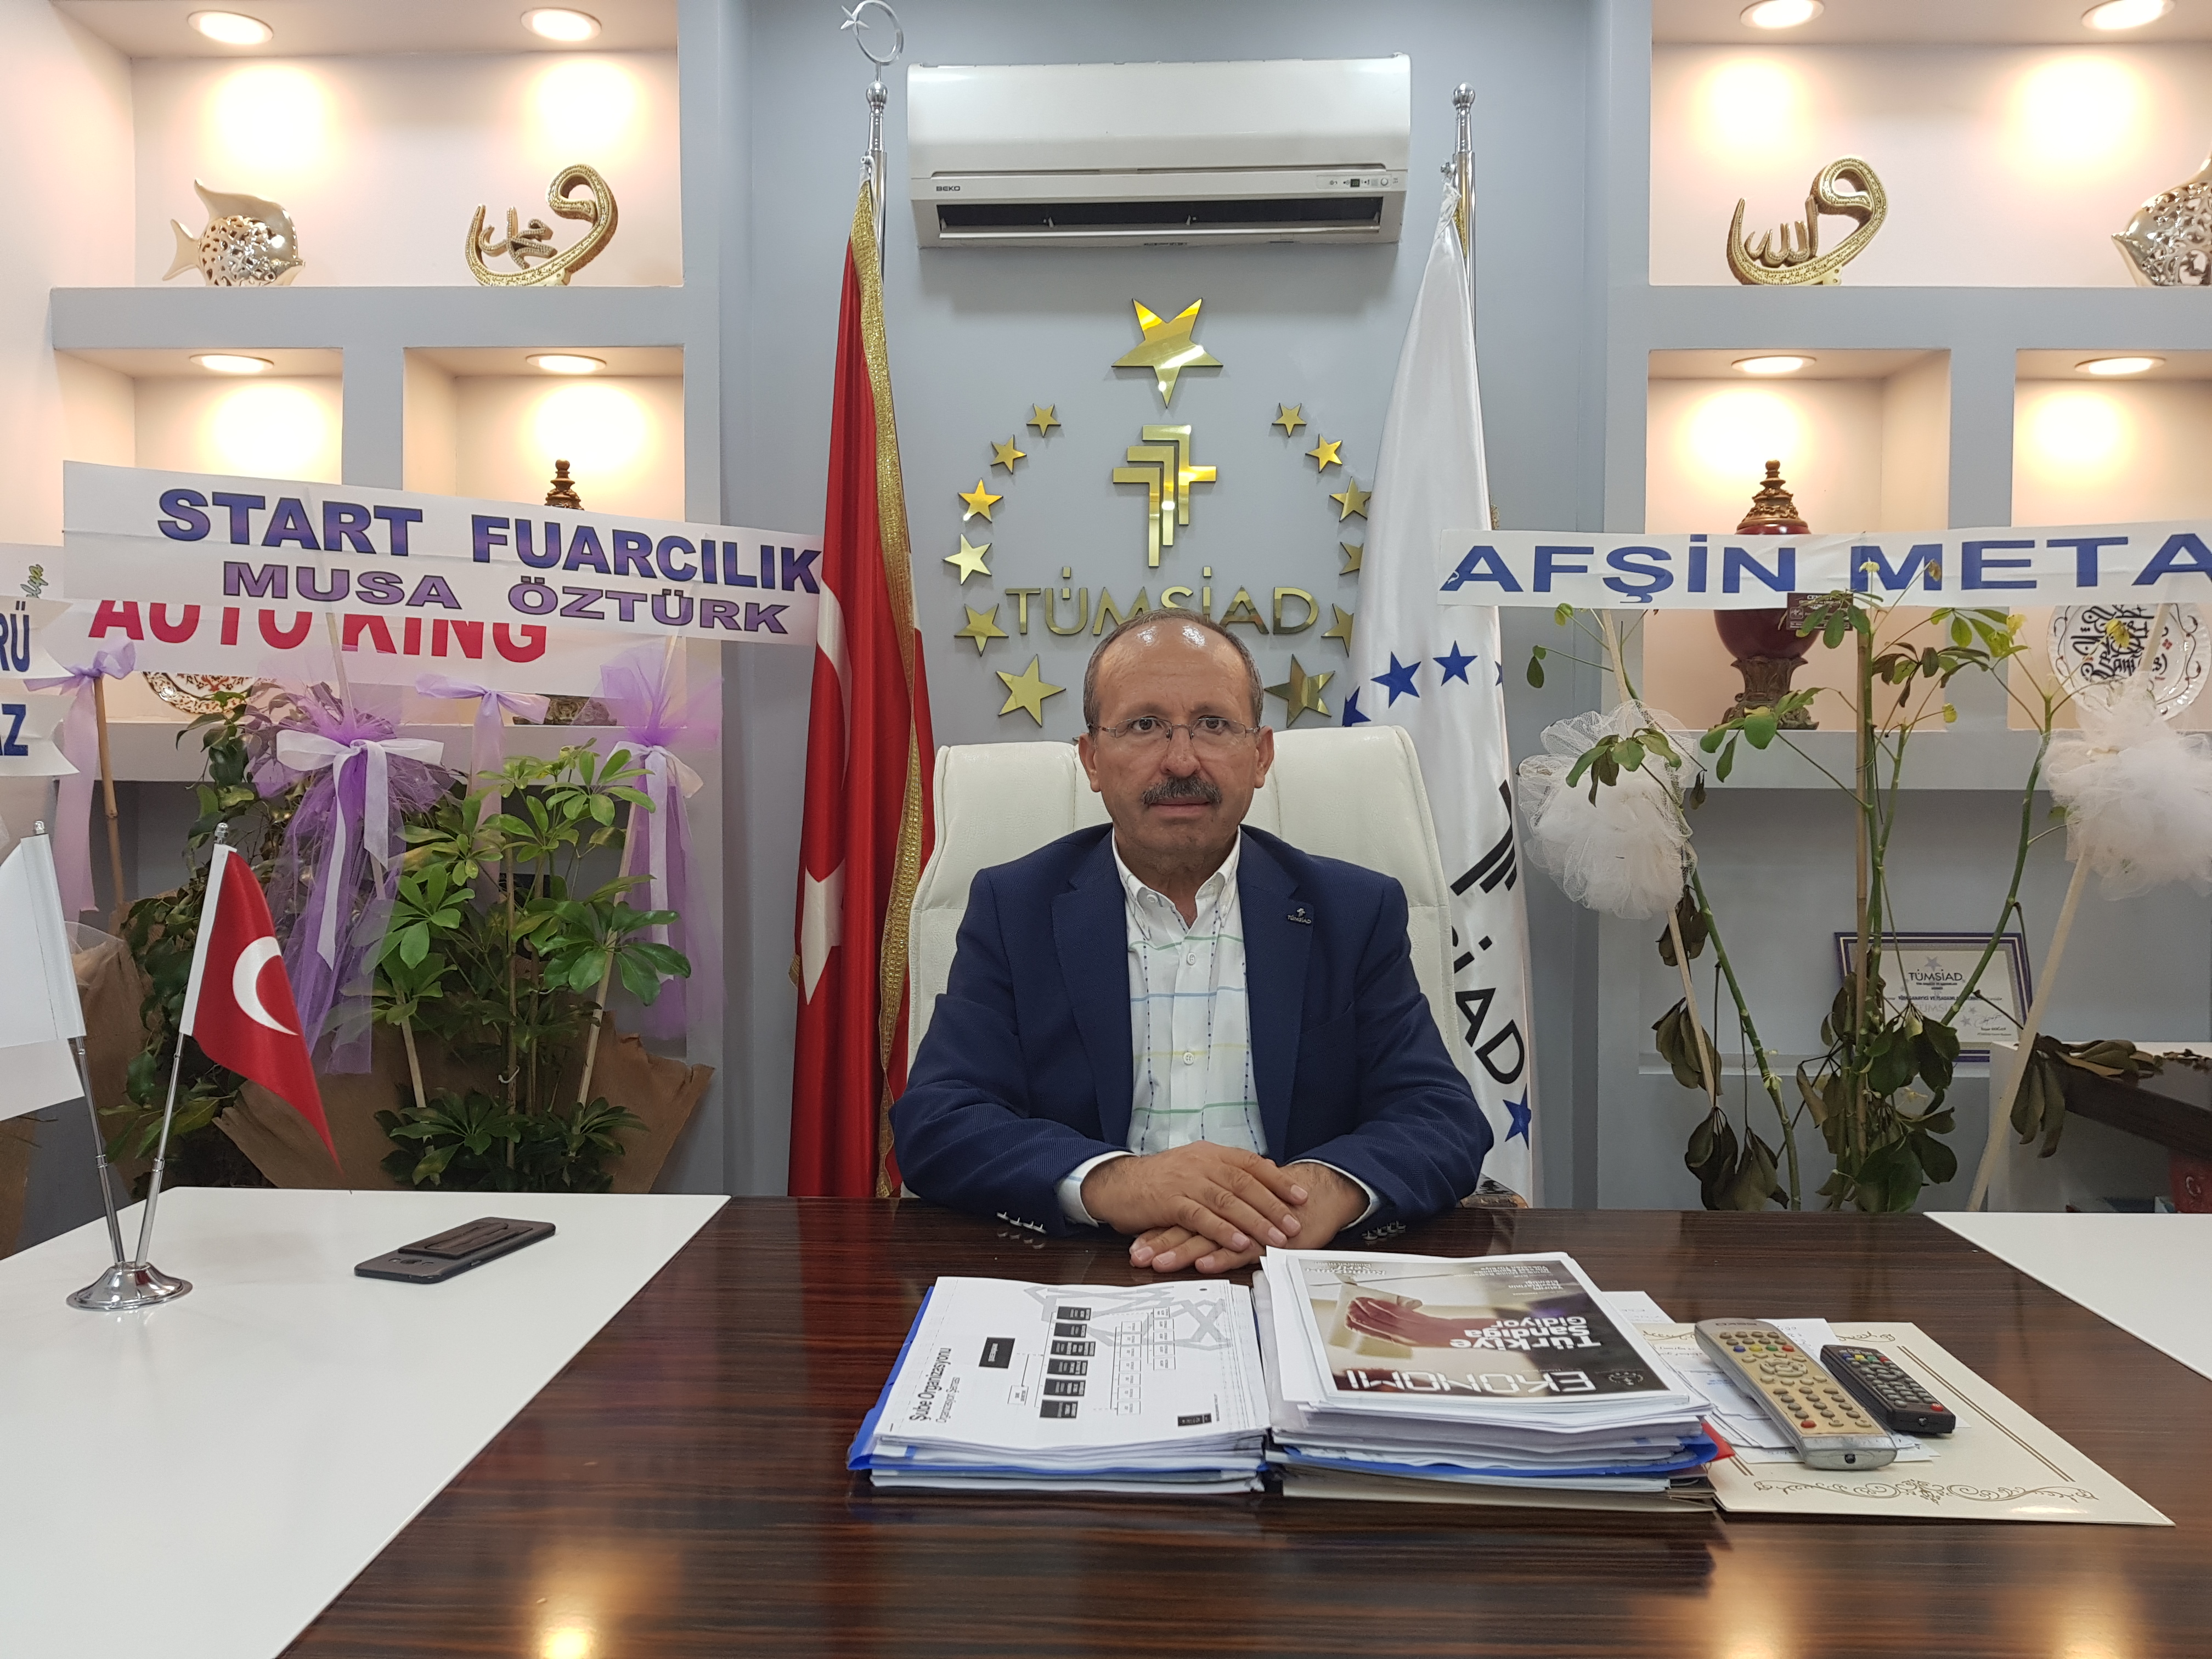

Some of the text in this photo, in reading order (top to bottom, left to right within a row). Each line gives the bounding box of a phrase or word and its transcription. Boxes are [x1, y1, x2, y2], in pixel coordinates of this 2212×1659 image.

[157, 488, 822, 594] START FUARCILIK
[1439, 533, 2212, 603] AFŞİN META
[223, 561, 790, 635] MUSA ÖZTÜRK
[0, 703, 29, 756] Z
[1908, 969, 1963, 981] TÜMSİAD
[1449, 1335, 1602, 1351] Türkiye
[1496, 1316, 1587, 1328] Gidiyor
[909, 1347, 952, 1421] Şube Organizasyonu
